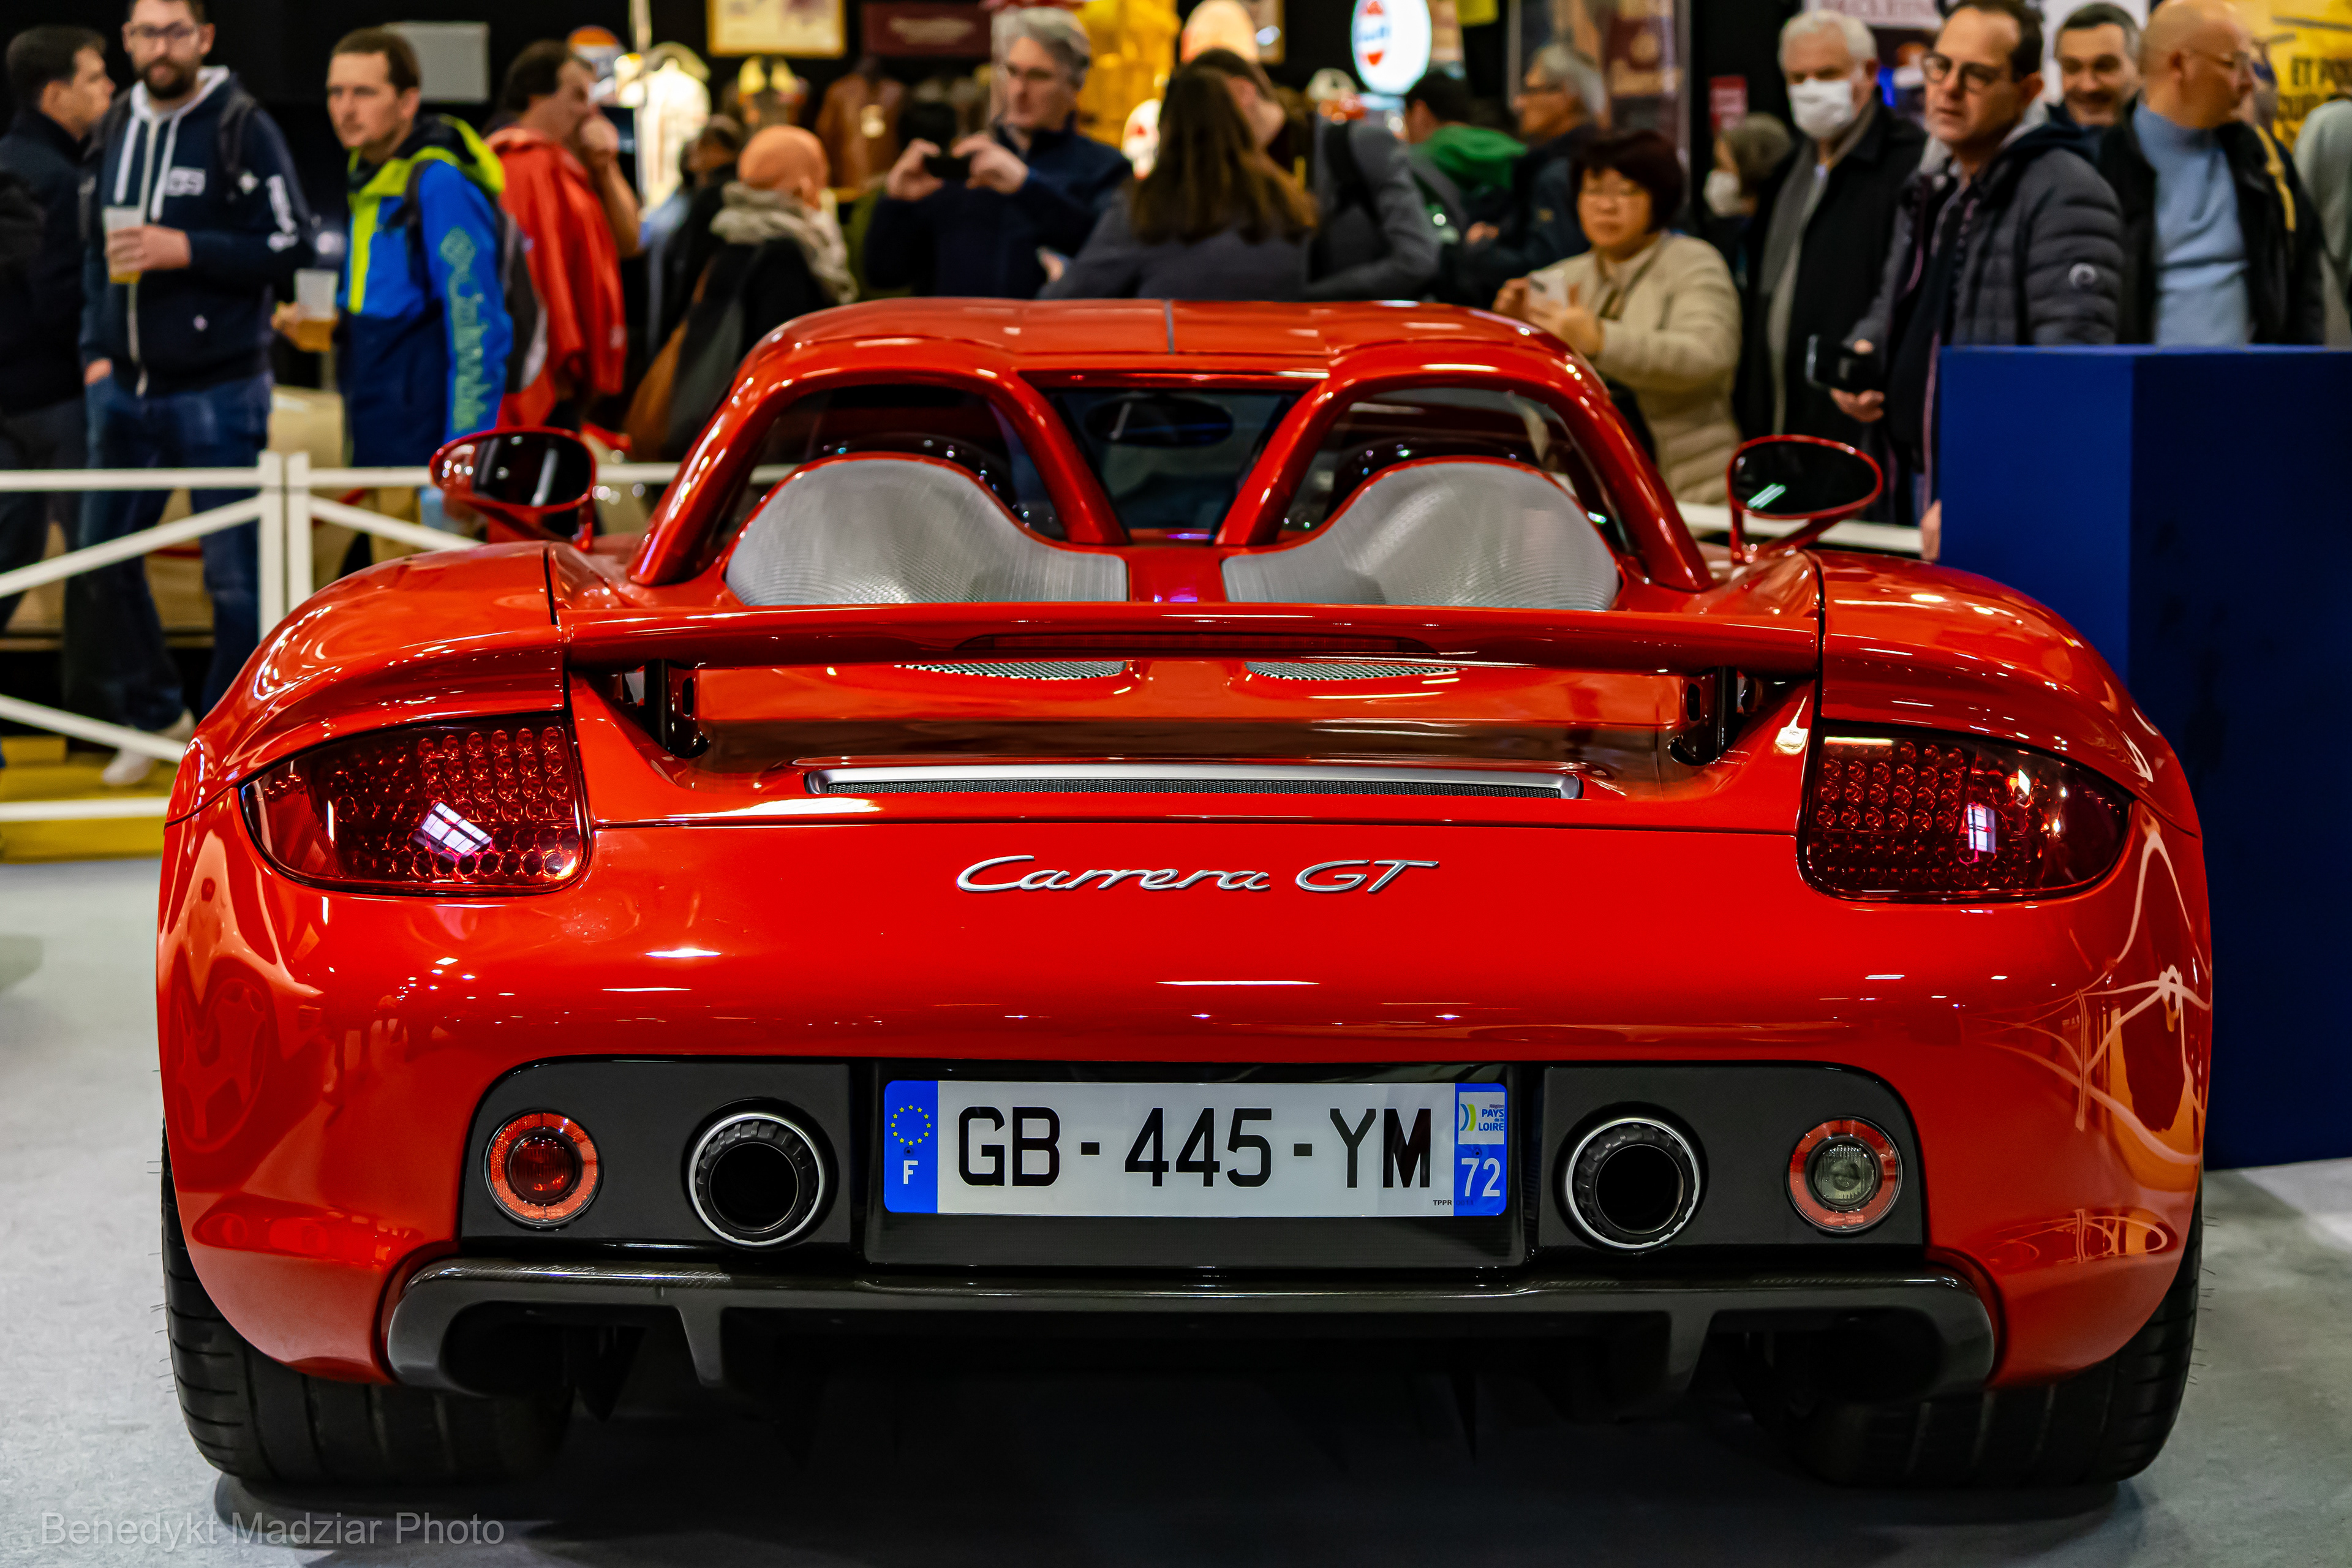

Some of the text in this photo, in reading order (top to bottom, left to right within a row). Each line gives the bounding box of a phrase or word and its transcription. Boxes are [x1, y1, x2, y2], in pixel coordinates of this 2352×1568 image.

[956, 854, 1439, 893] Carrera GT
[1481, 1108, 1505, 1118] PAYS
[1478, 1121, 1505, 1131] LOIRE
[903, 1160, 918, 1185] F
[1461, 1158, 1500, 1197] 72
